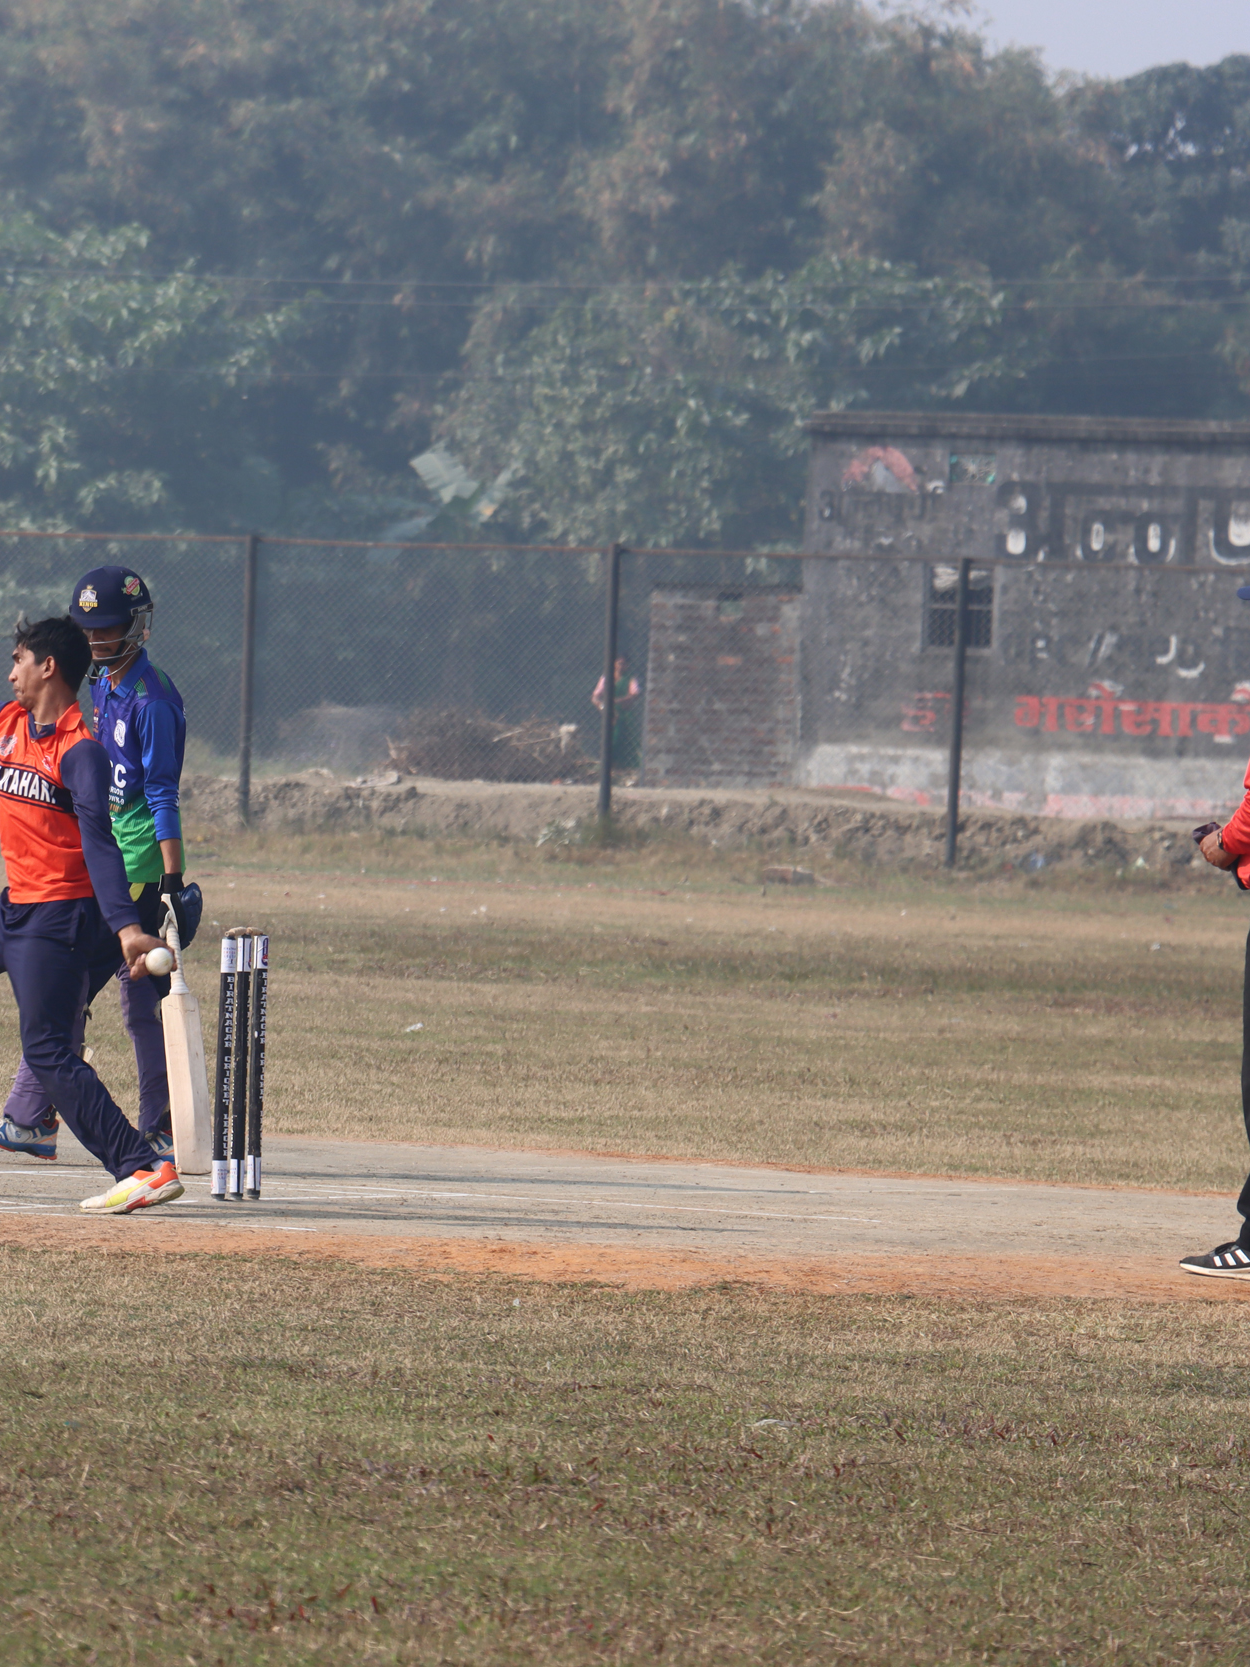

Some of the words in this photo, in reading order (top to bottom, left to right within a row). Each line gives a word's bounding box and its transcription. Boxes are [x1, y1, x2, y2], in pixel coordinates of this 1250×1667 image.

[109, 760, 127, 788] C
[224, 976, 235, 1048] BIRATNAGAR
[222, 1056, 231, 1105] CRICKET
